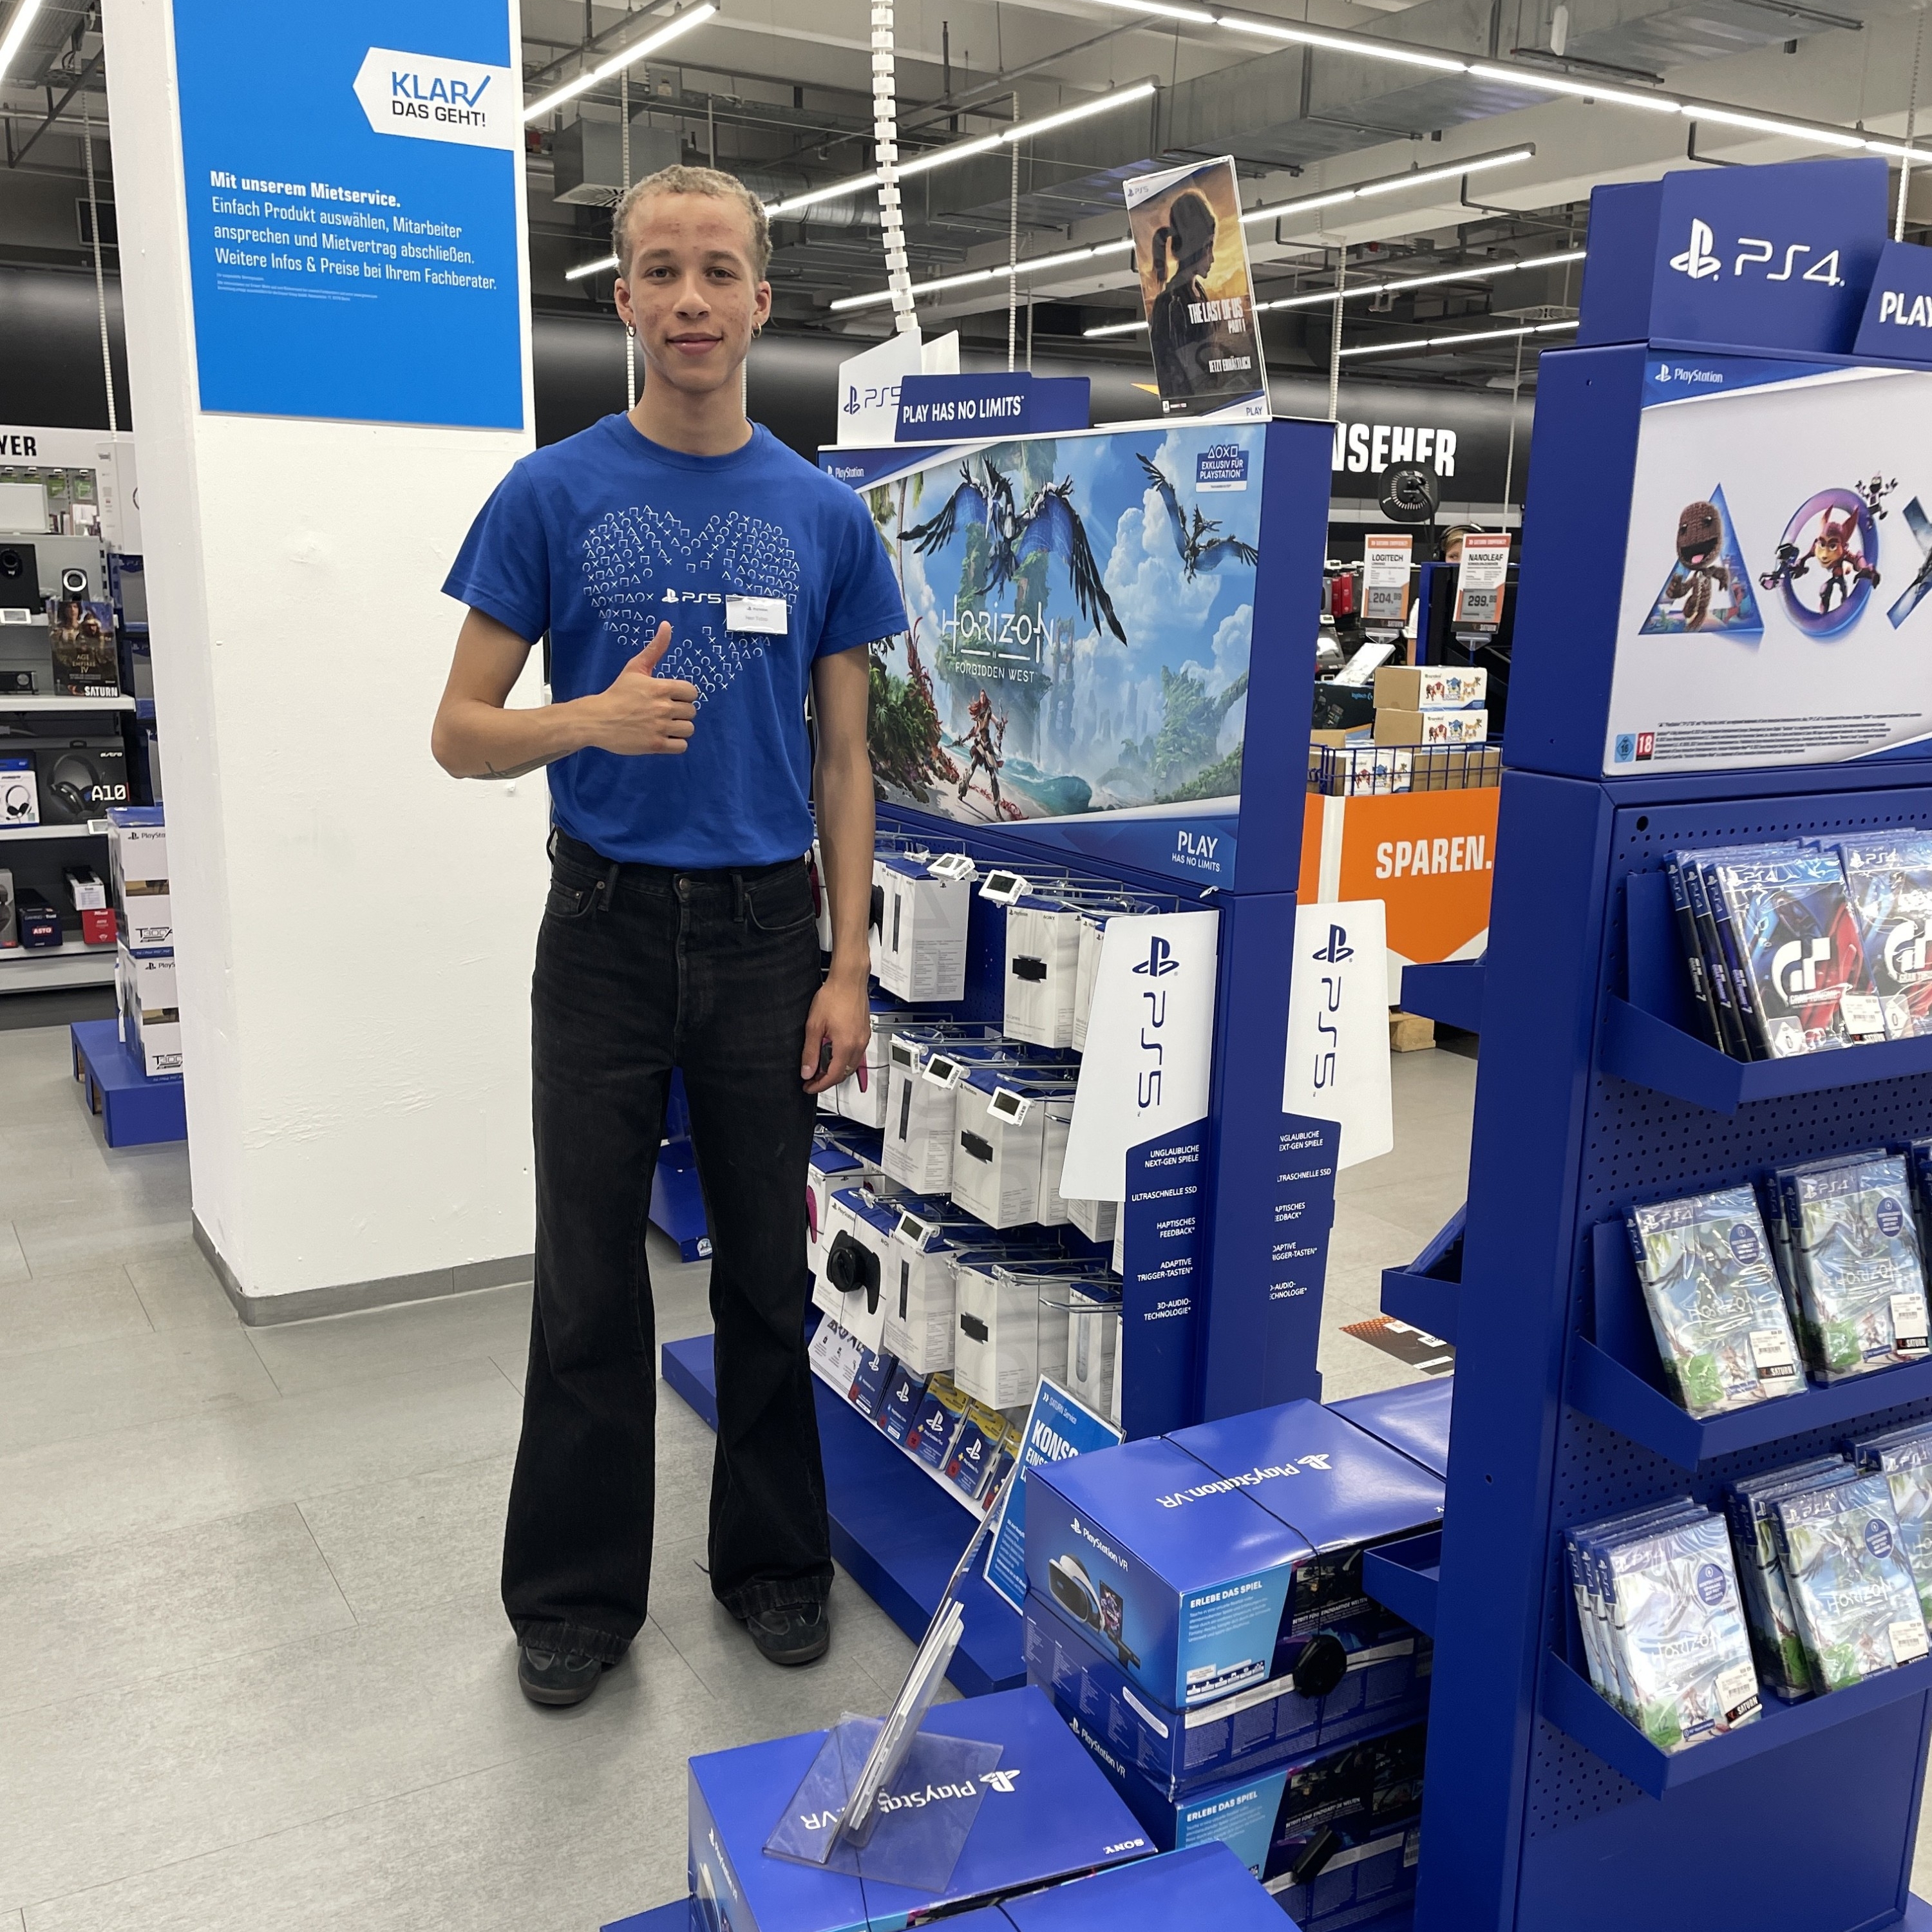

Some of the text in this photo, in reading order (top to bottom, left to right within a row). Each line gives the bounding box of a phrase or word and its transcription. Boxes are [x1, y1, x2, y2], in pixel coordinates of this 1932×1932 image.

[391, 71, 480, 107] KLAR
[392, 100, 486, 128] DAS GEHT!
[210, 170, 401, 208] Mit unserem Mietservice.
[1135, 185, 1149, 194] PS5
[212, 197, 462, 239] Einfach Produkt auswählen, Mitarbeiter
[214, 225, 475, 265] ansprechen und Mietvertrag abschließen.
[215, 247, 497, 290] Weitere Infos & Preise bei Ihrem Fachberater.
[1734, 238, 1841, 287] PS4
[1188, 303, 1203, 324] THE
[1202, 300, 1222, 322] LAST
[1227, 319, 1242, 334] PART
[1674, 368, 1723, 384] PlayStation
[865, 387, 901, 408] PS5
[904, 395, 1021, 423] PLAY HAS NO LIMITS
[1246, 406, 1262, 416] PLAY
[835, 467, 864, 478] PlayStation
[1200, 469, 1241, 480] PLAYSTATION
[1202, 460, 1231, 470] EXKLUSIV
[682, 592, 722, 603] PS5
[942, 594, 1054, 663] HORIZON
[955, 662, 1036, 683] FORBIDDEN WEST
[84, 686, 118, 697] SATURN
[1638, 735, 1653, 753] 18
[91, 784, 126, 802] A10
[1178, 831, 1218, 860] PLAY
[1171, 853, 1220, 873] HAS NO LIMITS
[1376, 835, 1493, 879] SPAREN.
[1314, 976, 1341, 1089] PS5
[1138, 990, 1166, 1108] PS5
[1150, 1144, 1199, 1158] UNGLAUBLICHE
[1304, 1138, 1323, 1148] SPIELE
[1144, 1154, 1199, 1168] NEXT-GEN SPIELE
[1320, 1168, 1332, 1177] SSD
[1132, 1186, 1197, 1202] ULTRASCHNELLE SSD
[1819, 1180, 1850, 1195] PS4
[1157, 1217, 1196, 1230] HAPTISCHES
[1160, 1258, 1192, 1269] ADAPTIVE
[1157, 1298, 1192, 1311] 3D-AUDIO-
[1770, 1365, 1793, 1376] SATURN
[1156, 1463, 1300, 1509] PlayStation VR
[1083, 1528, 1128, 1573] PlayStation VR
[1190, 1580, 1263, 1609] ERLEBE DAS SPIEL
[1600, 1573, 1611, 1597] PS4
[1737, 1696, 1759, 1715] SATURN
[1081, 1727, 1126, 1779] PlayStation VR
[1187, 1790, 1258, 1822] ERLEBE DAS SPIEL
[1102, 1839, 1144, 1855] SONY
